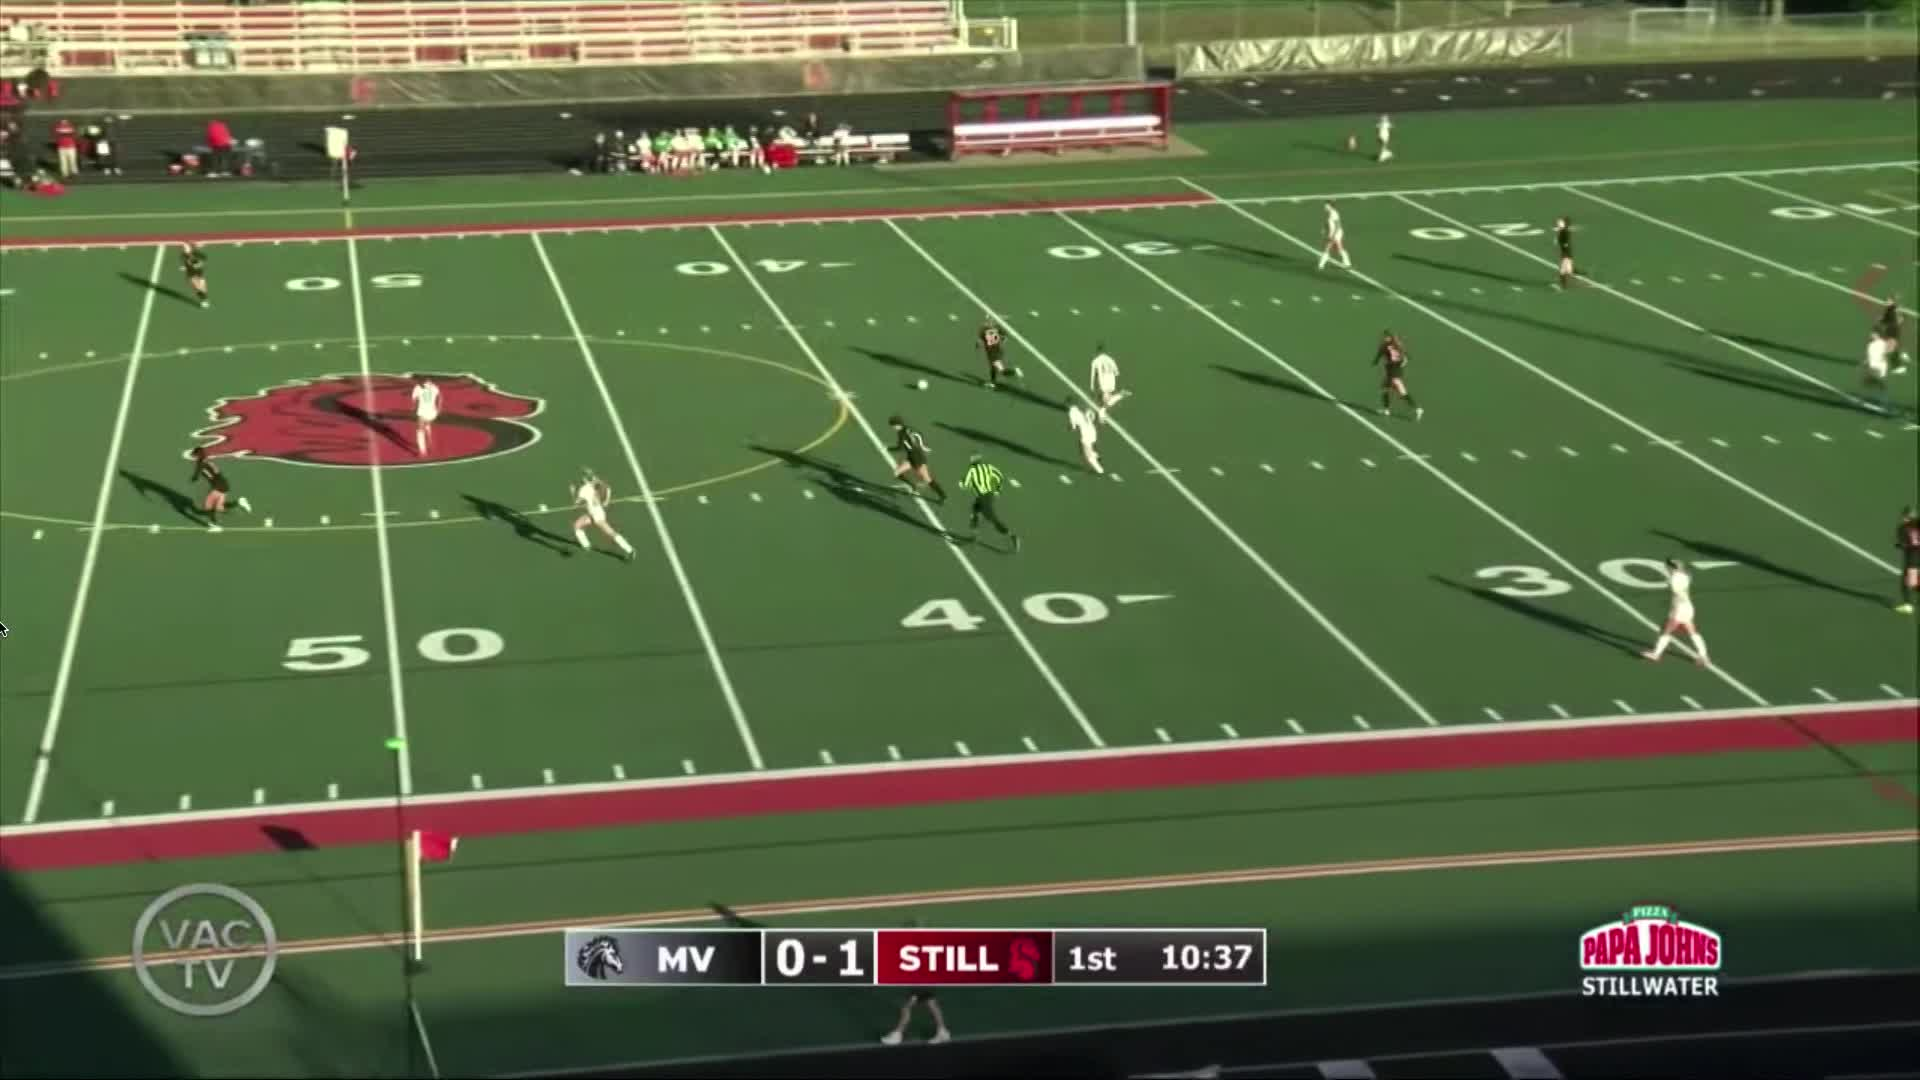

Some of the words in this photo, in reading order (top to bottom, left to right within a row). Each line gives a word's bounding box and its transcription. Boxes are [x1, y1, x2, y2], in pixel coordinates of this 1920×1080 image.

[1475, 557, 1672, 598] 30
[901, 592, 1109, 631] 40
[282, 627, 505, 672] 50
